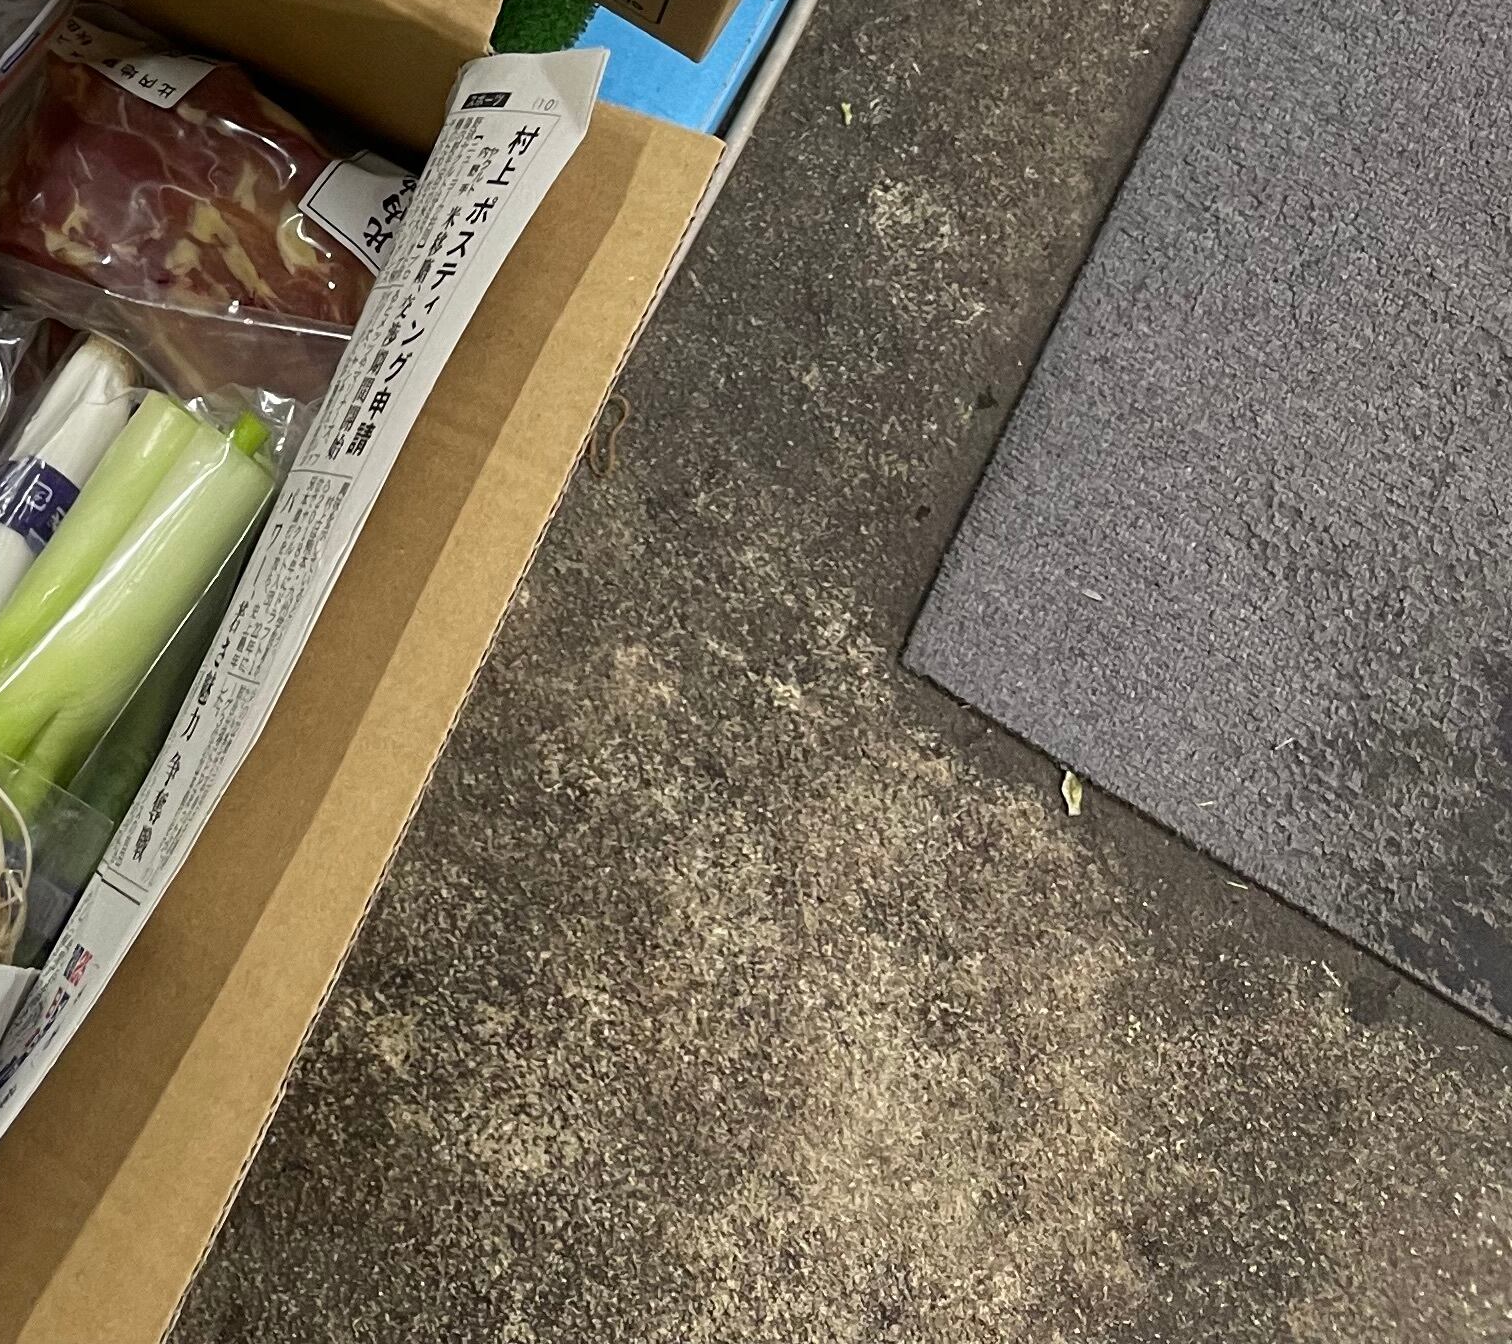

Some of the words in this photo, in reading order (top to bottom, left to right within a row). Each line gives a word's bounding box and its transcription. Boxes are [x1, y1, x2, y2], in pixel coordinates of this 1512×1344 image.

[343, 120, 541, 460] 村上ポスティング申請
